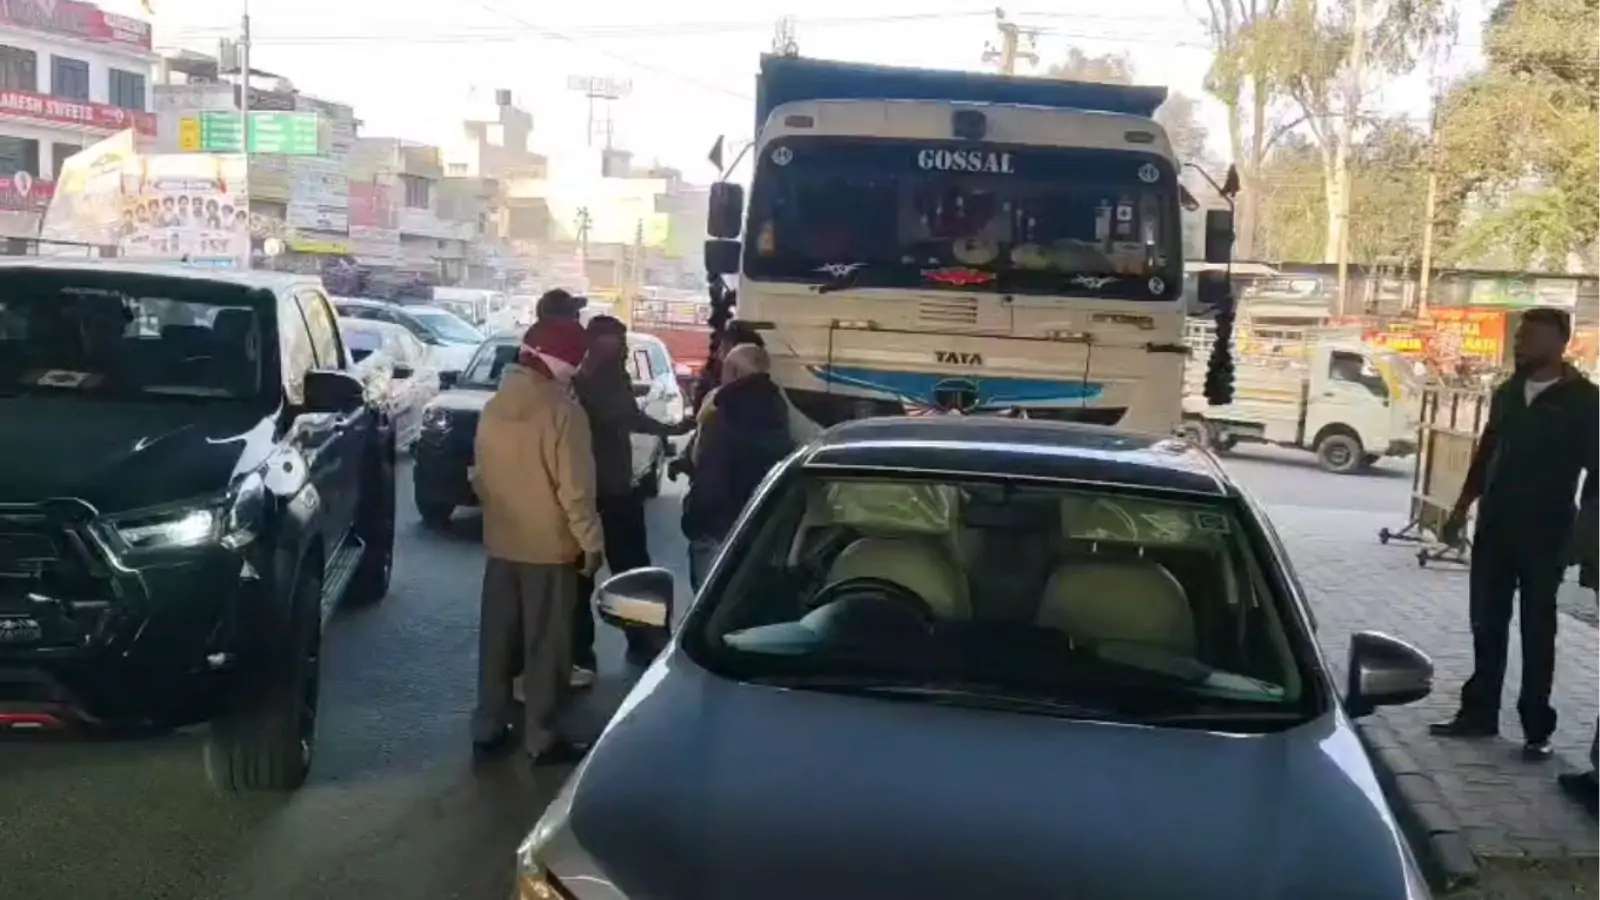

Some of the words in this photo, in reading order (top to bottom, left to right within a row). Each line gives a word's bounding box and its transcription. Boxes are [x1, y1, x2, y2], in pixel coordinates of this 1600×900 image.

[45, 101, 94, 120] SWEETS
[918, 149, 1015, 174] GOSSAL
[934, 350, 982, 365] TATA
